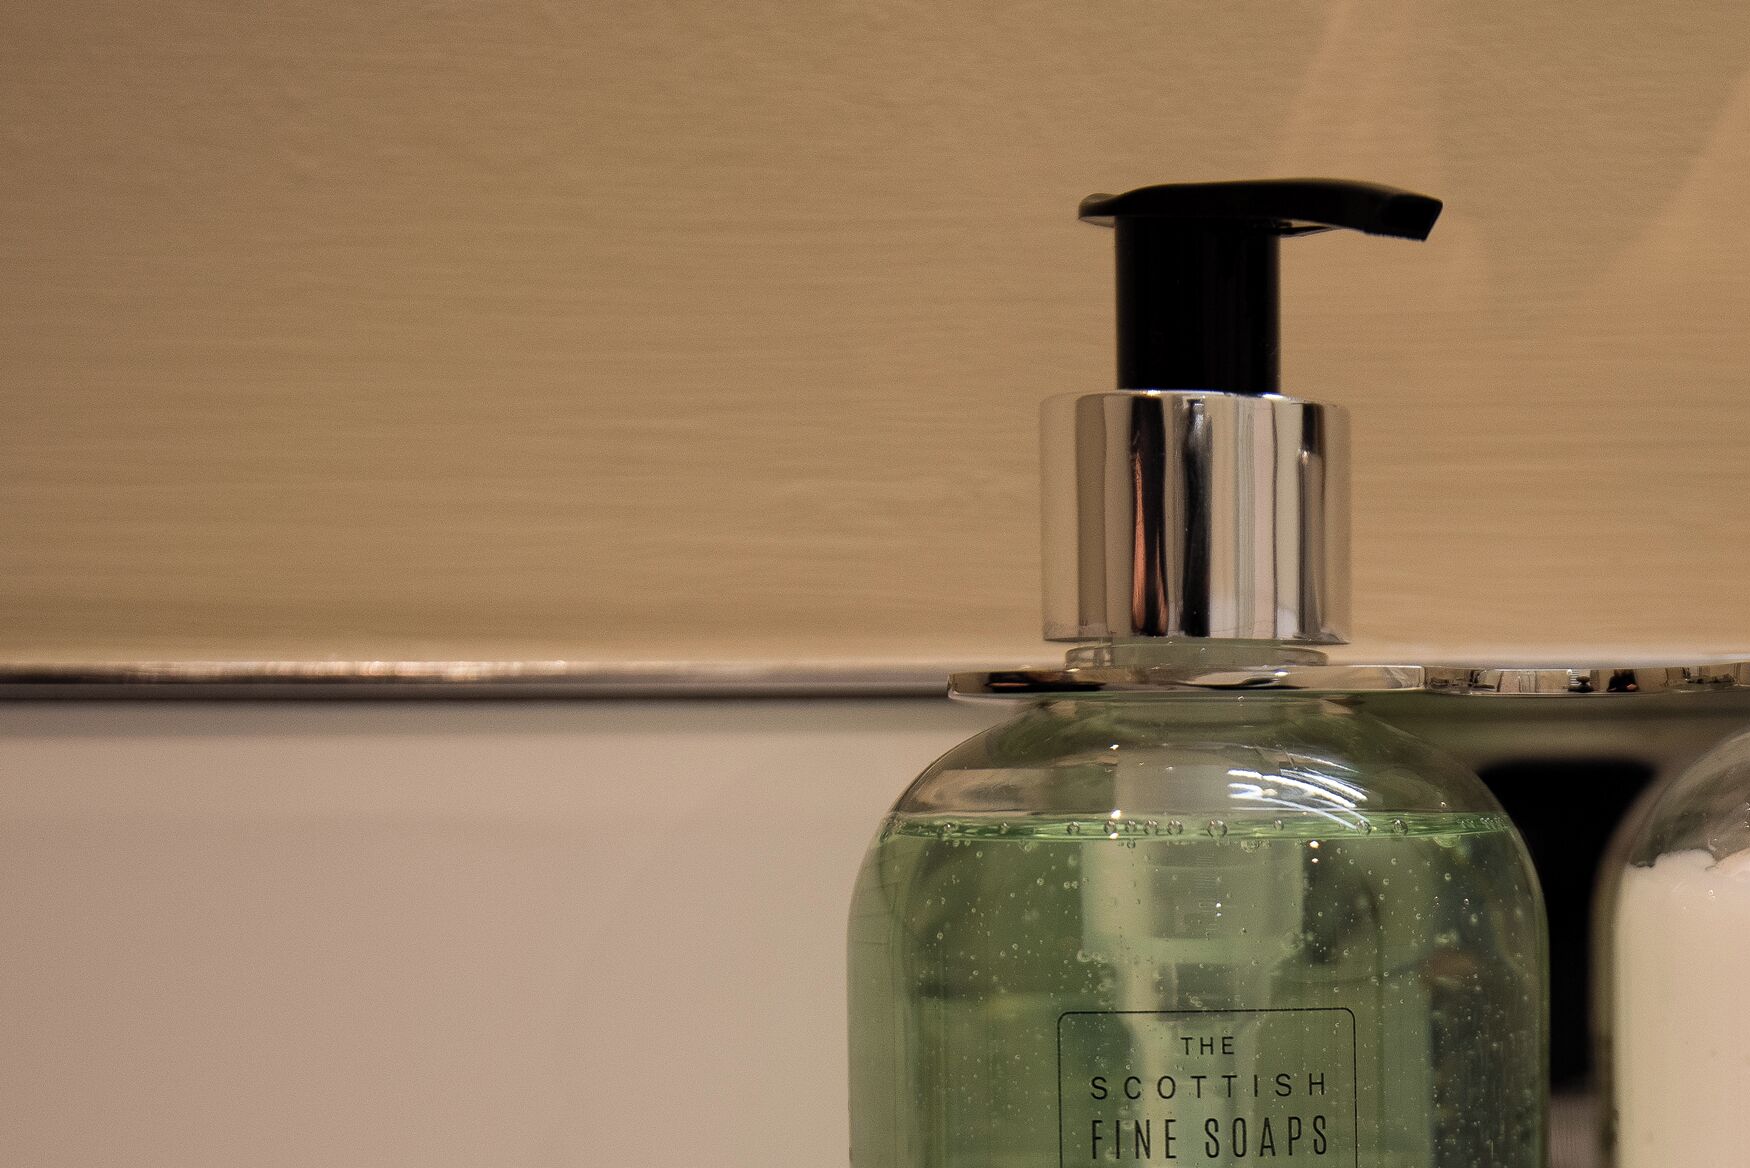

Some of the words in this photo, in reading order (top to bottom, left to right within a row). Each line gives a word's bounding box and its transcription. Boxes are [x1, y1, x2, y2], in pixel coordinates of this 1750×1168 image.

[1181, 1036, 1235, 1056] THE
[1090, 1073, 1326, 1100] SCOTTISH
[1091, 1118, 1177, 1160] FINE
[1205, 1114, 1328, 1159] SOAPS
